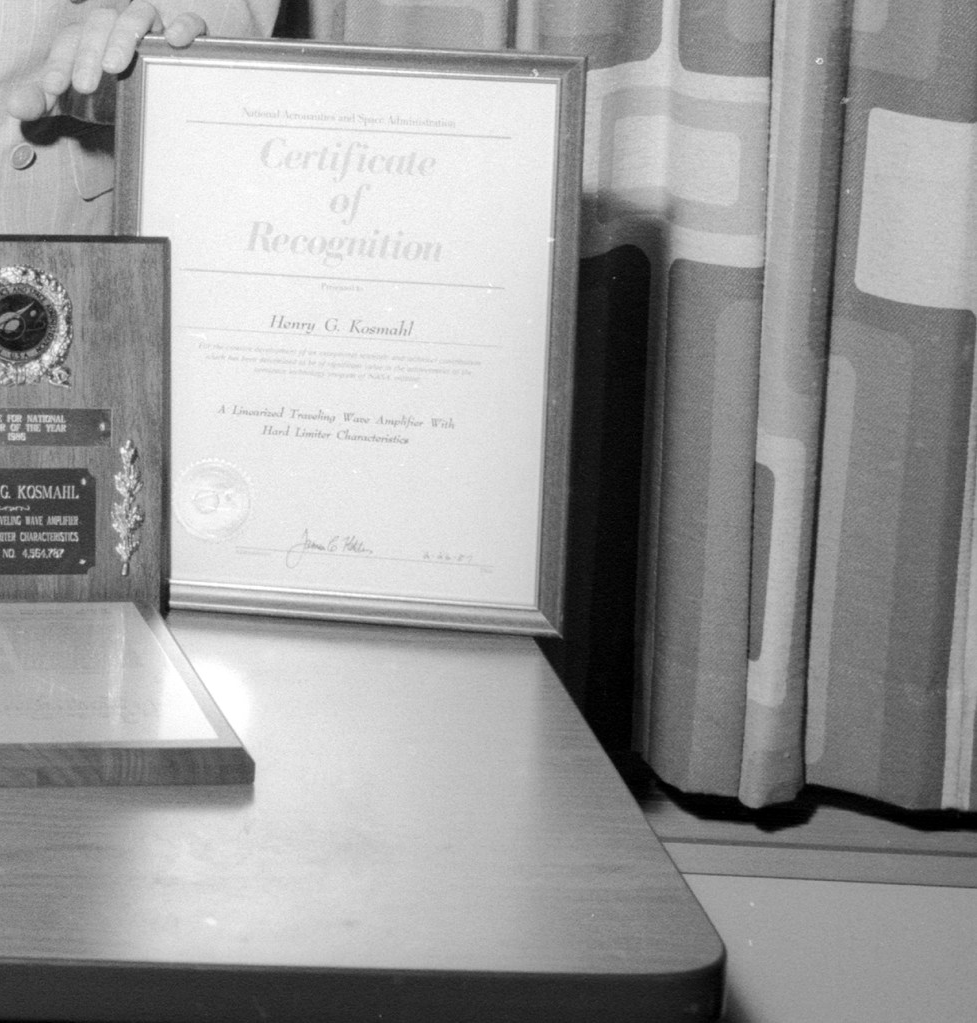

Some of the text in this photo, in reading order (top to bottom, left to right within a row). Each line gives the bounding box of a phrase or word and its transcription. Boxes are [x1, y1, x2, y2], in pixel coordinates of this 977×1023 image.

[243, 107, 456, 129] National Aeronautics and Space Administration
[260, 136, 436, 183] Certificate
[329, 184, 370, 224] of
[245, 221, 443, 267] Recognition
[270, 314, 415, 337] Henry G. Kosmahl
[7, 414, 23, 423] FOR
[27, 414, 66, 423] NATIONAL
[217, 403, 456, 429] A Linearized Traveling Wave Amplifier With
[10, 423, 22, 432] OF
[25, 423, 41, 432] THE
[45, 423, 67, 432] YEAR
[261, 424, 410, 445] Hard Limiter Characteristics
[0, 485, 11, 499] G.
[17, 485, 80, 500] KOSMAHL
[25, 515, 44, 526] WAVE
[47, 515, 79, 526] AMPLIFIER
[19, 532, 79, 542] CHARACTERISTICS
